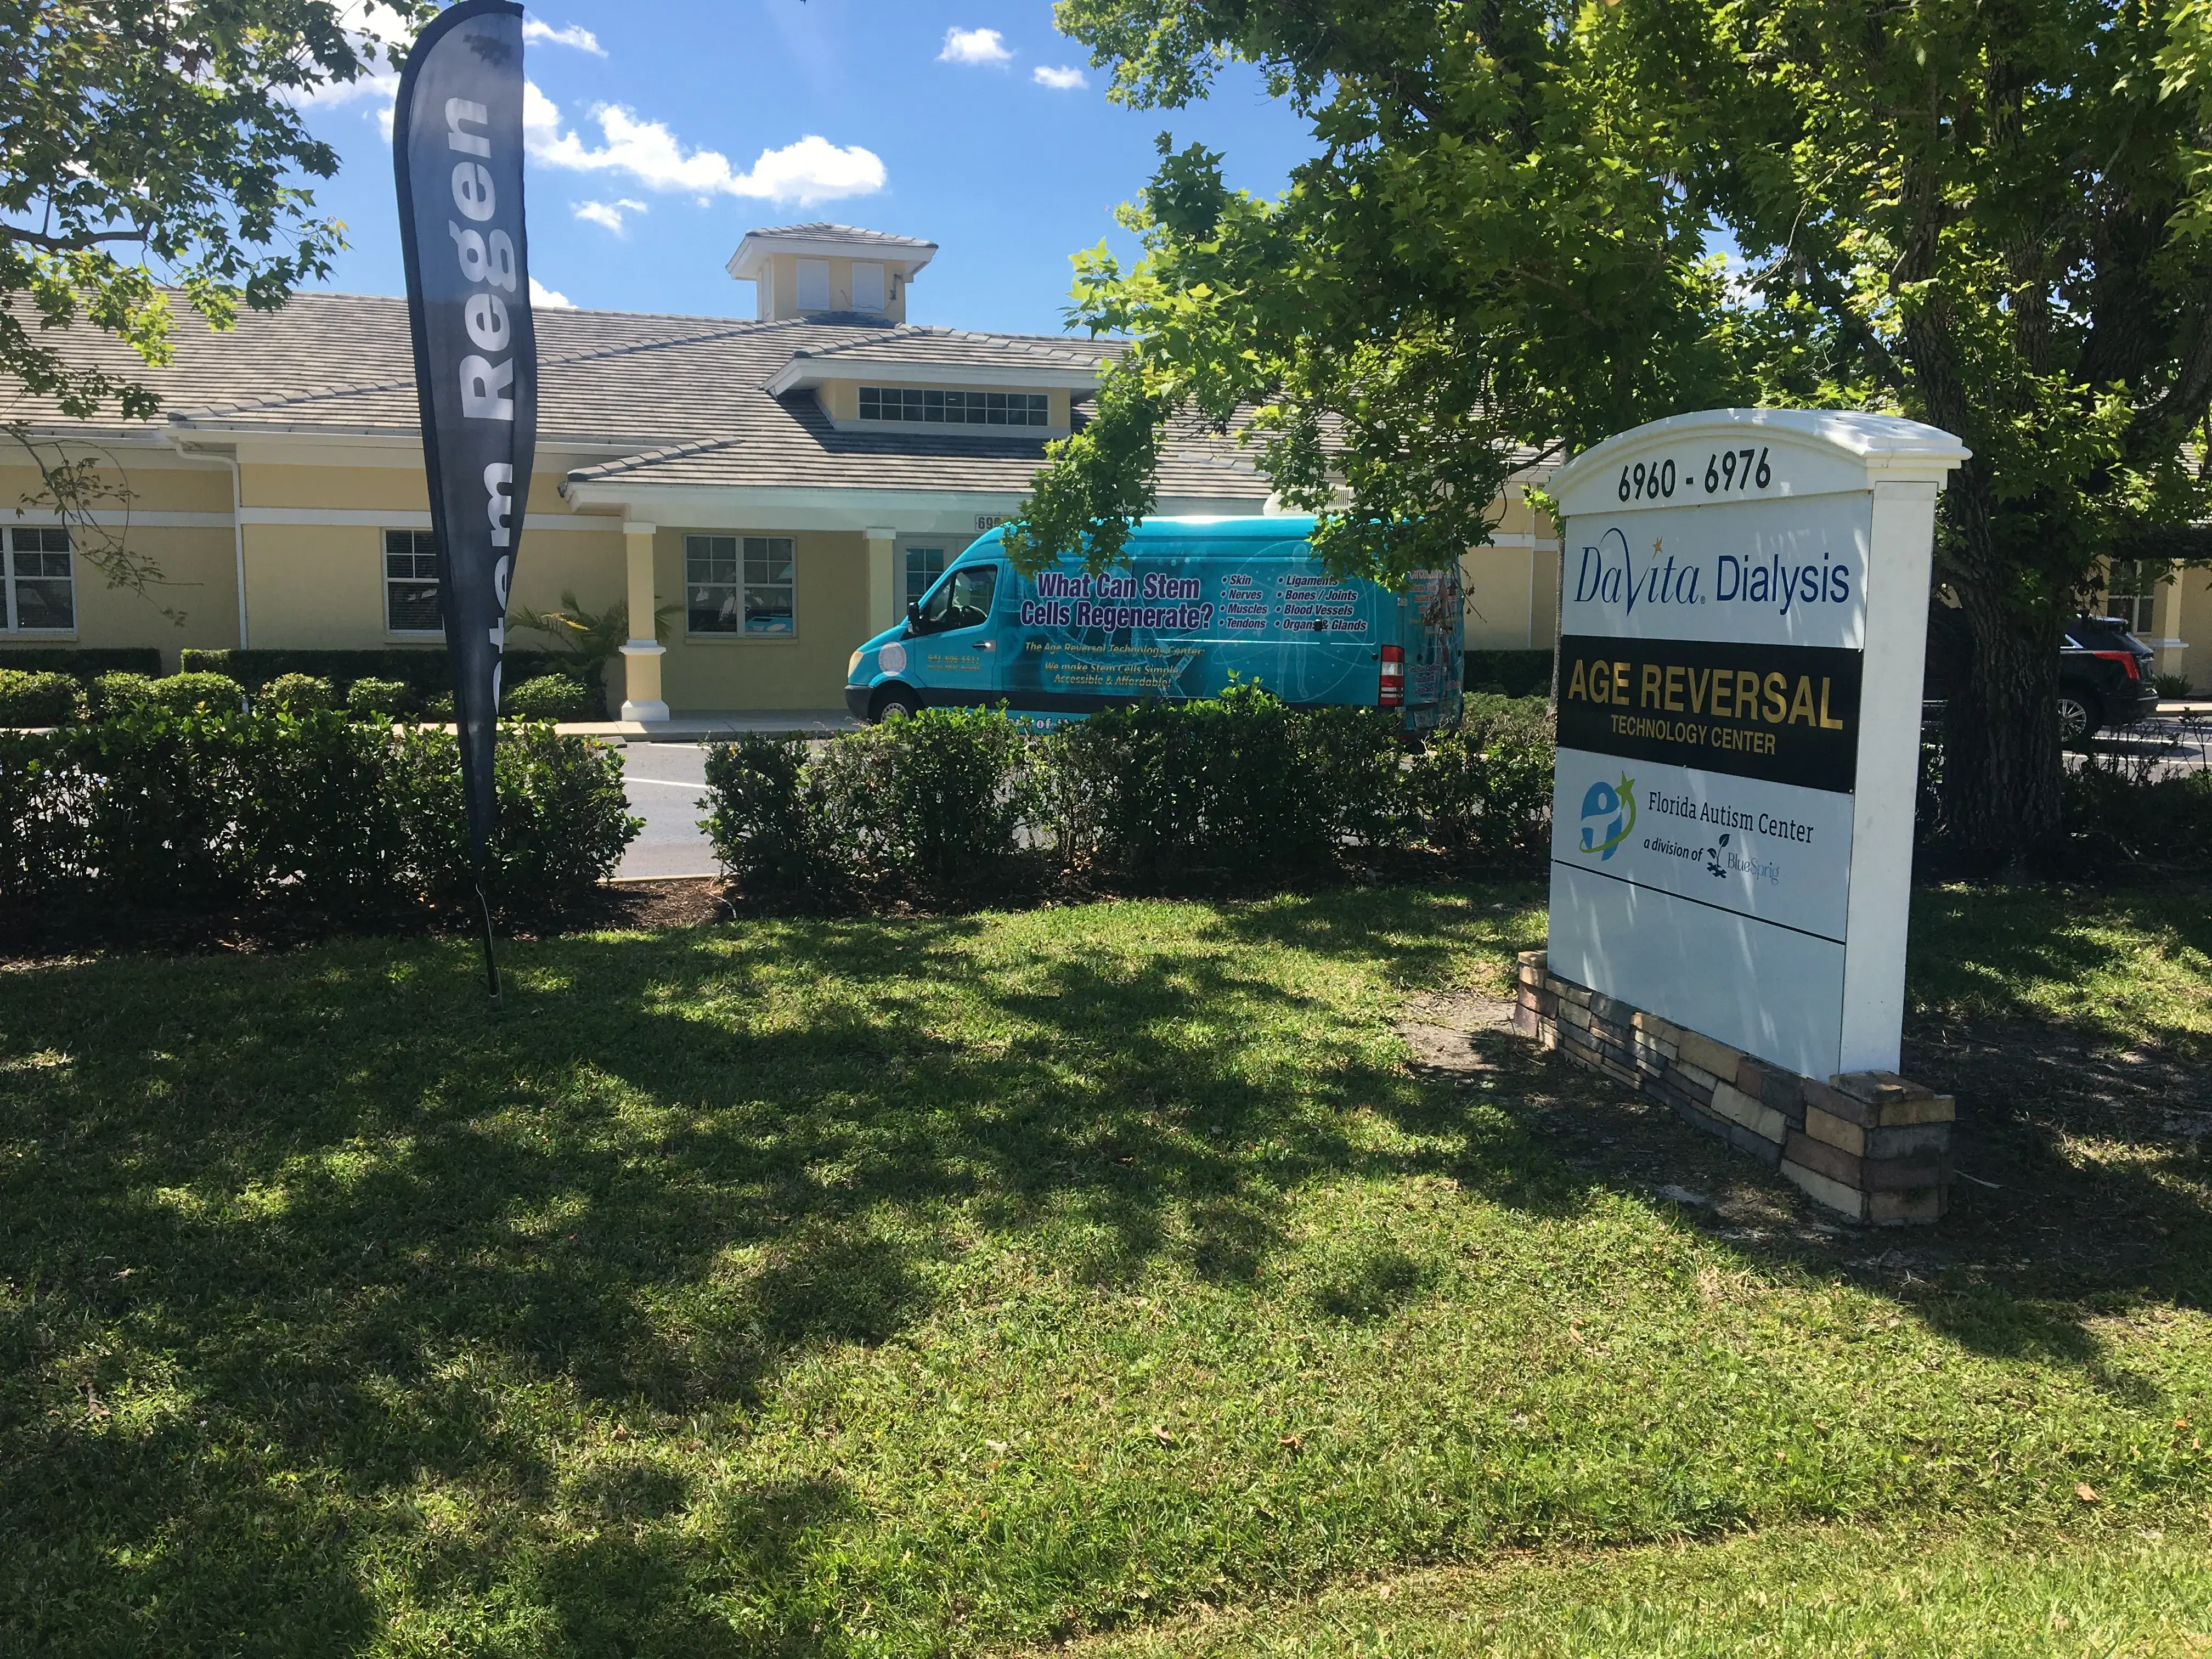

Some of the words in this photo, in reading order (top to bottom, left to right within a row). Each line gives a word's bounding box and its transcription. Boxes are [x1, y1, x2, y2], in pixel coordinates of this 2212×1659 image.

[445, 97, 517, 421] Regen
[1618, 459, 1676, 503] 6960
[1704, 447, 1771, 493] 6976
[1037, 572, 1091, 598] What
[1096, 572, 1137, 599] Can
[1143, 573, 1201, 600] Stem
[1229, 575, 1251, 585] Skin
[1716, 552, 1850, 616] Dialysis
[1228, 589, 1262, 600] Nerves
[1285, 590, 1316, 601] Bones
[1325, 590, 1358, 601] Joints
[1227, 603, 1268, 614] Muscles
[1284, 604, 1313, 616] Blood
[1315, 605, 1353, 617] Vessels
[1021, 600, 1070, 626] Cells
[1076, 600, 1214, 633] Regenerate?
[1226, 618, 1266, 629] Tendons
[1322, 620, 1329, 630] &
[1331, 620, 1367, 631] Glands
[1025, 642, 1042, 652] The
[1044, 642, 1062, 654] Age
[1064, 643, 1106, 653] Reversal
[1109, 644, 1166, 657] Technology
[1045, 662, 1059, 671] We
[1061, 662, 1088, 672] make
[1091, 664, 1115, 672] Stem
[1118, 664, 1141, 674] Cells
[1054, 674, 1103, 684] Accessible
[1105, 675, 1113, 685] &
[1115, 676, 1171, 687] Affordable!
[1567, 659, 1630, 706] AGE
[1640, 663, 1843, 731] REVERSAL
[1036, 717, 1052, 729] of
[1611, 714, 1707, 746] TECHNOLOGY
[1711, 726, 1776, 755] CENTER
[1648, 791, 1696, 820] Florida
[1700, 802, 1753, 831] Autism
[1758, 813, 1814, 843] Center
[1644, 838, 1650, 849] a
[1651, 837, 1689, 860] division
[1691, 848, 1704, 862] of
